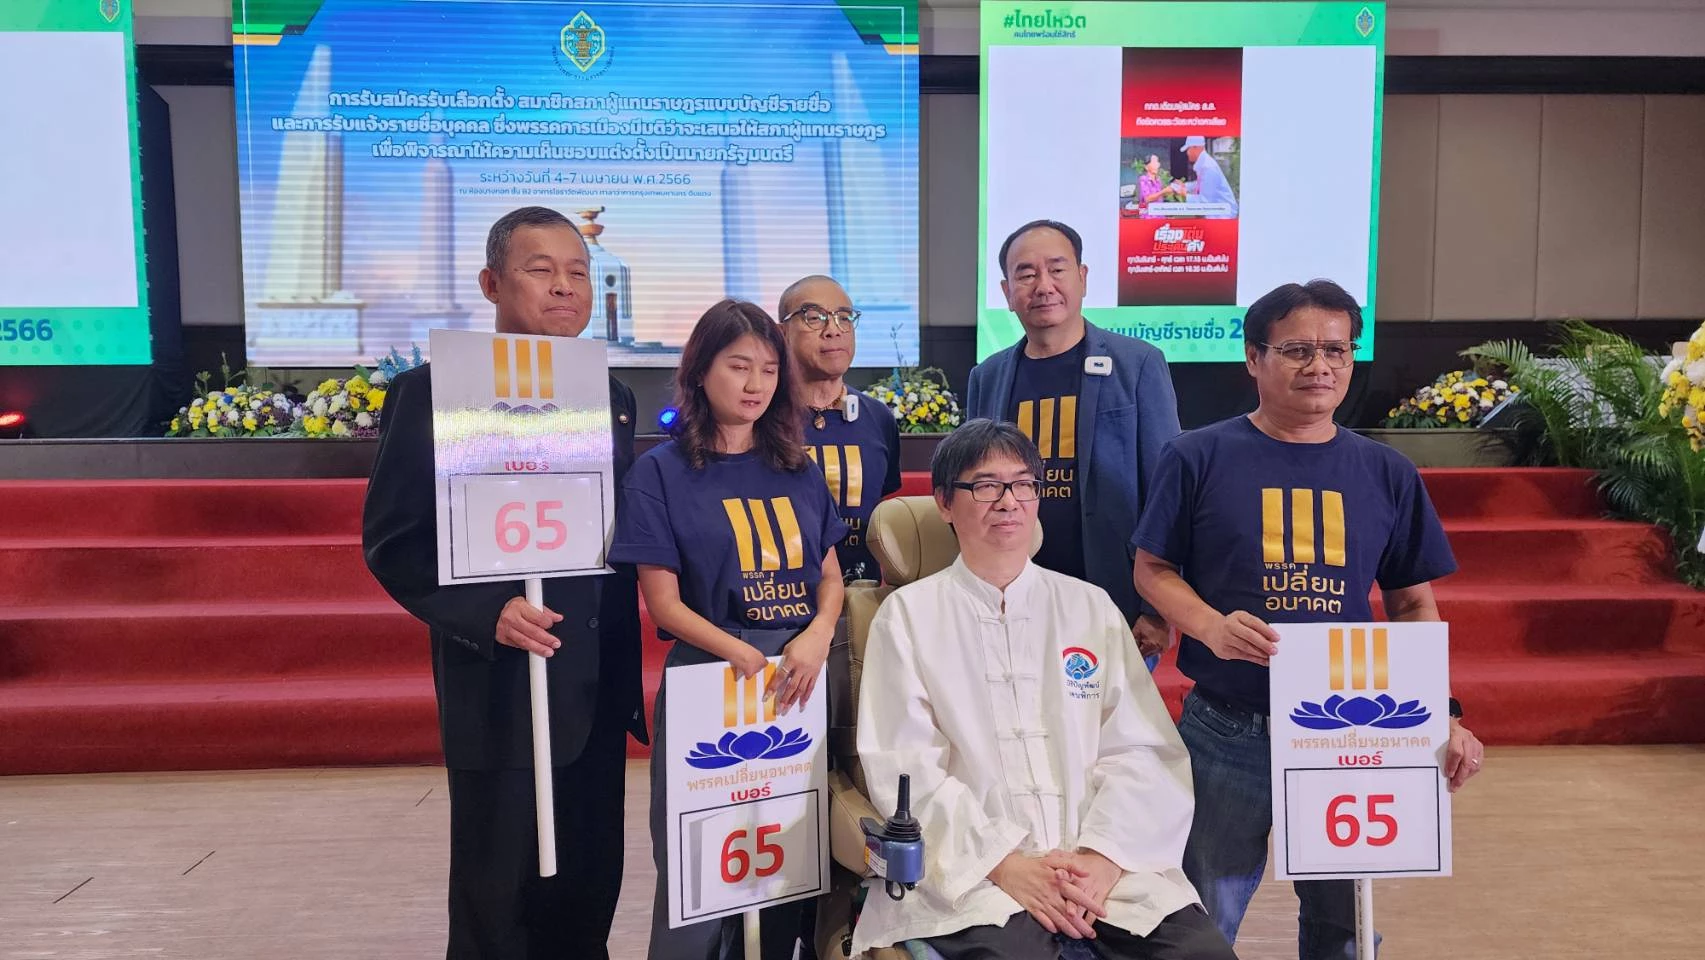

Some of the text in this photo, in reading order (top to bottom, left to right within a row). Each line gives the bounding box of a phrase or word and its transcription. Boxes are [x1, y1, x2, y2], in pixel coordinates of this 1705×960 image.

[1003, 9, 1087, 29] #ไทยโหวต
[328, 86, 832, 115] การรับสมัครรับเลือกตั้ง สมาชิกสภาผู้แทนราษฎรแบบบัญชีรายชื่อ
[271, 111, 490, 138] และการรับแจ้งรายชื่อบุคคล
[371, 137, 793, 165] เพื่อพิจารณาให้ความเห็นชอบแต่งตั้งเป็นนายกรัฐมนตรี
[480, 167, 550, 184] ระหว่างวันที่
[554, 172, 577, 184] 4-7
[581, 173, 629, 185] เมษายน
[0, 319, 53, 341] 566
[495, 500, 567, 553] 65
[743, 573, 807, 602] เปลี่ยน
[1263, 564, 1345, 595] เปลี่ยน
[747, 602, 811, 621] อนาคต
[1265, 596, 1342, 614] อนาคต
[1290, 728, 1432, 750] พรรคเปลี่ยนอนาคต
[1338, 751, 1383, 766] เบอร์
[686, 761, 813, 792] พรรคเปลี่ยนอนาคต
[730, 782, 773, 802] เบอร์
[1326, 794, 1399, 848] 65
[720, 824, 785, 884] 65
